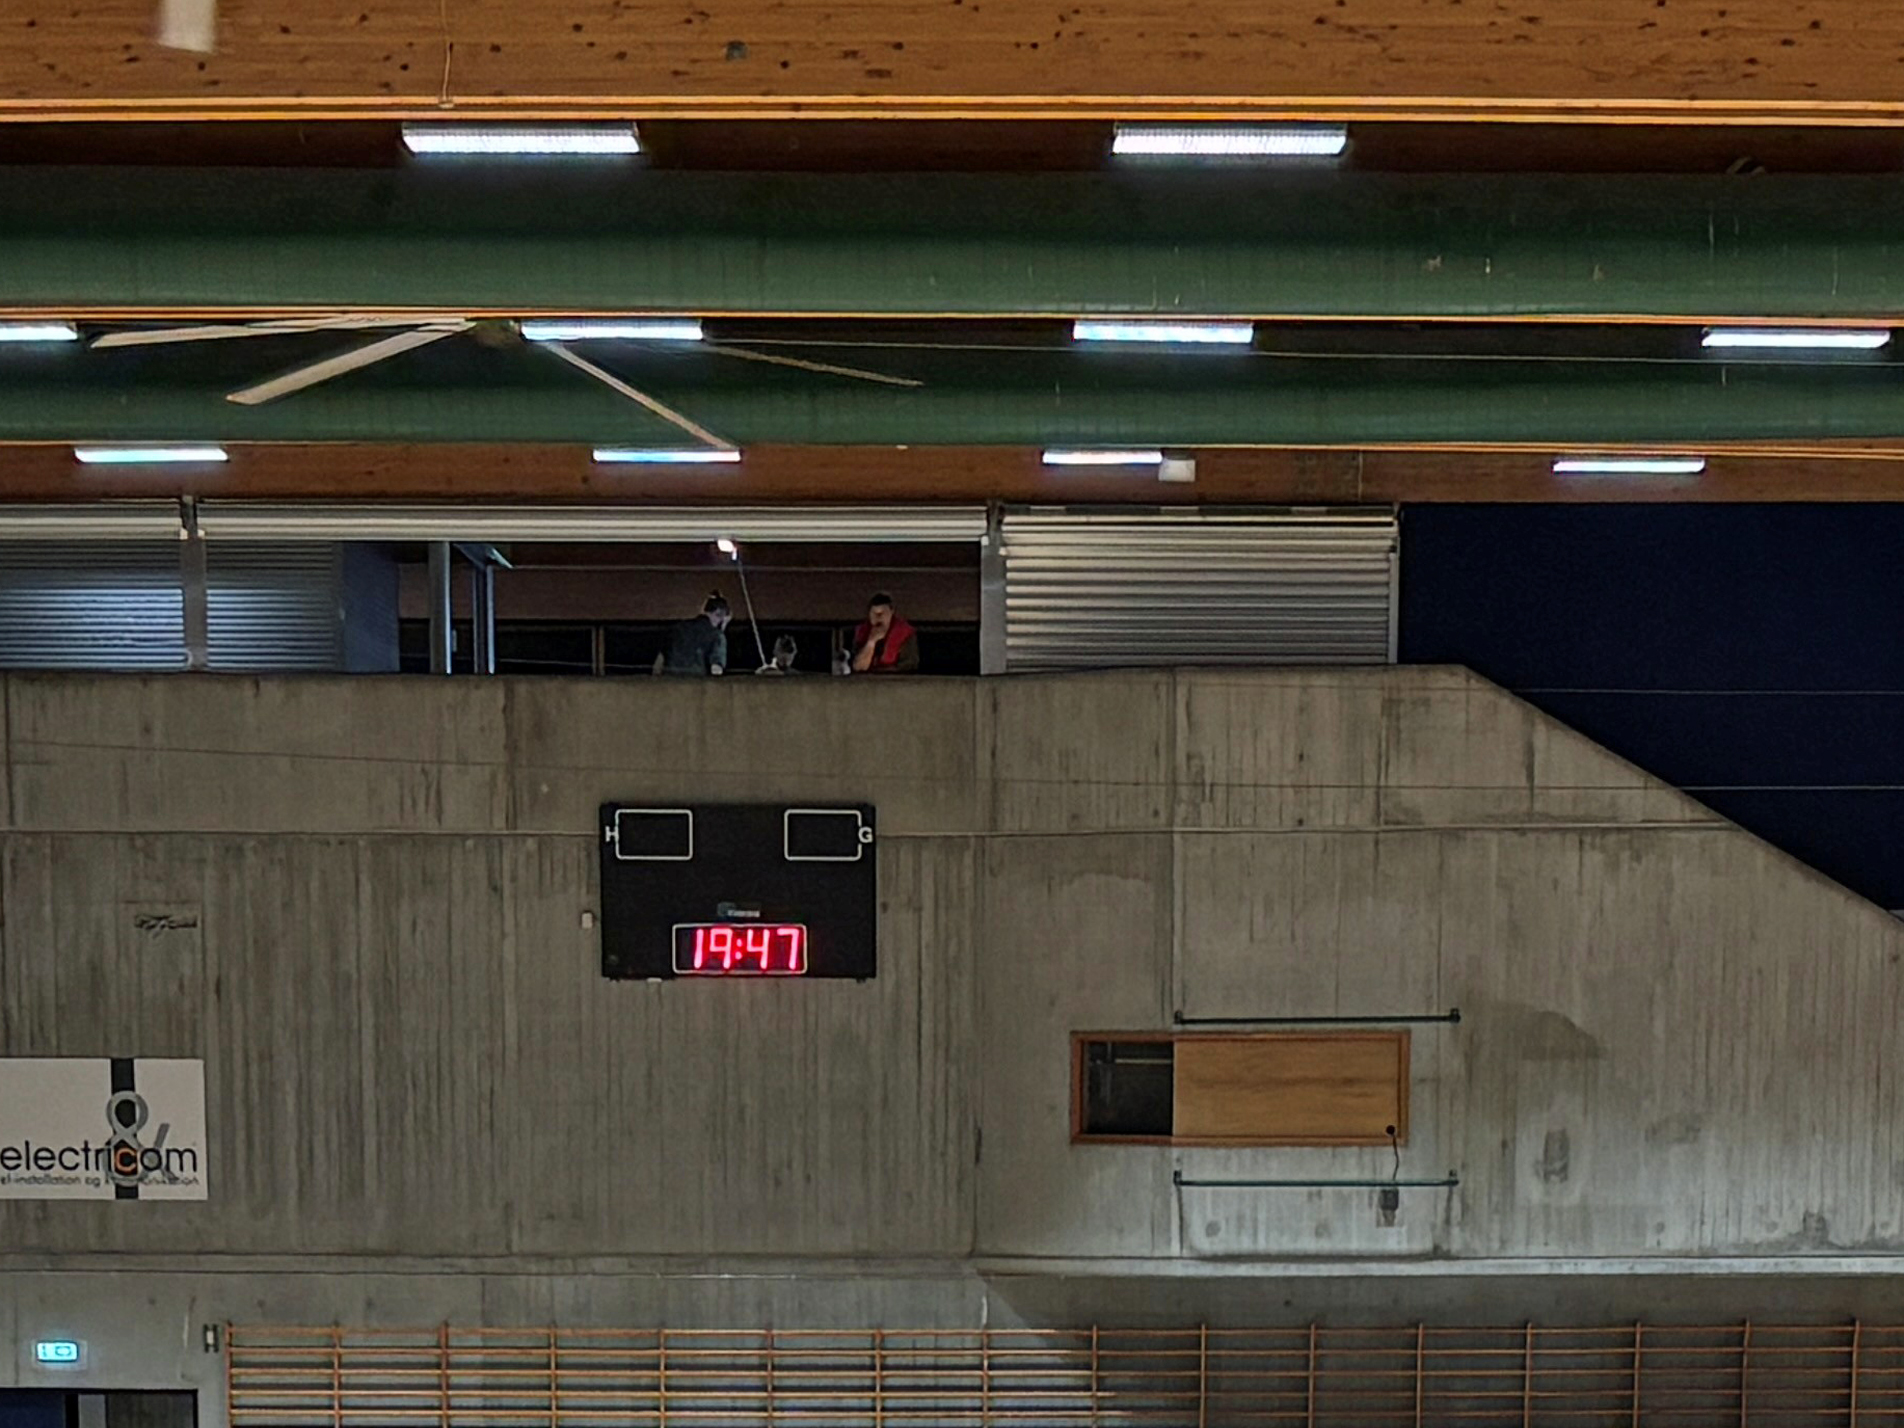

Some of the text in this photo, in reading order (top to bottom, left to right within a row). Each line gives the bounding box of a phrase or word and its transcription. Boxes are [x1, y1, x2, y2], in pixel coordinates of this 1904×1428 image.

[605, 826, 620, 842] H
[858, 827, 873, 843] G
[694, 928, 801, 970] 19:47
[0, 1140, 197, 1177] electricom
